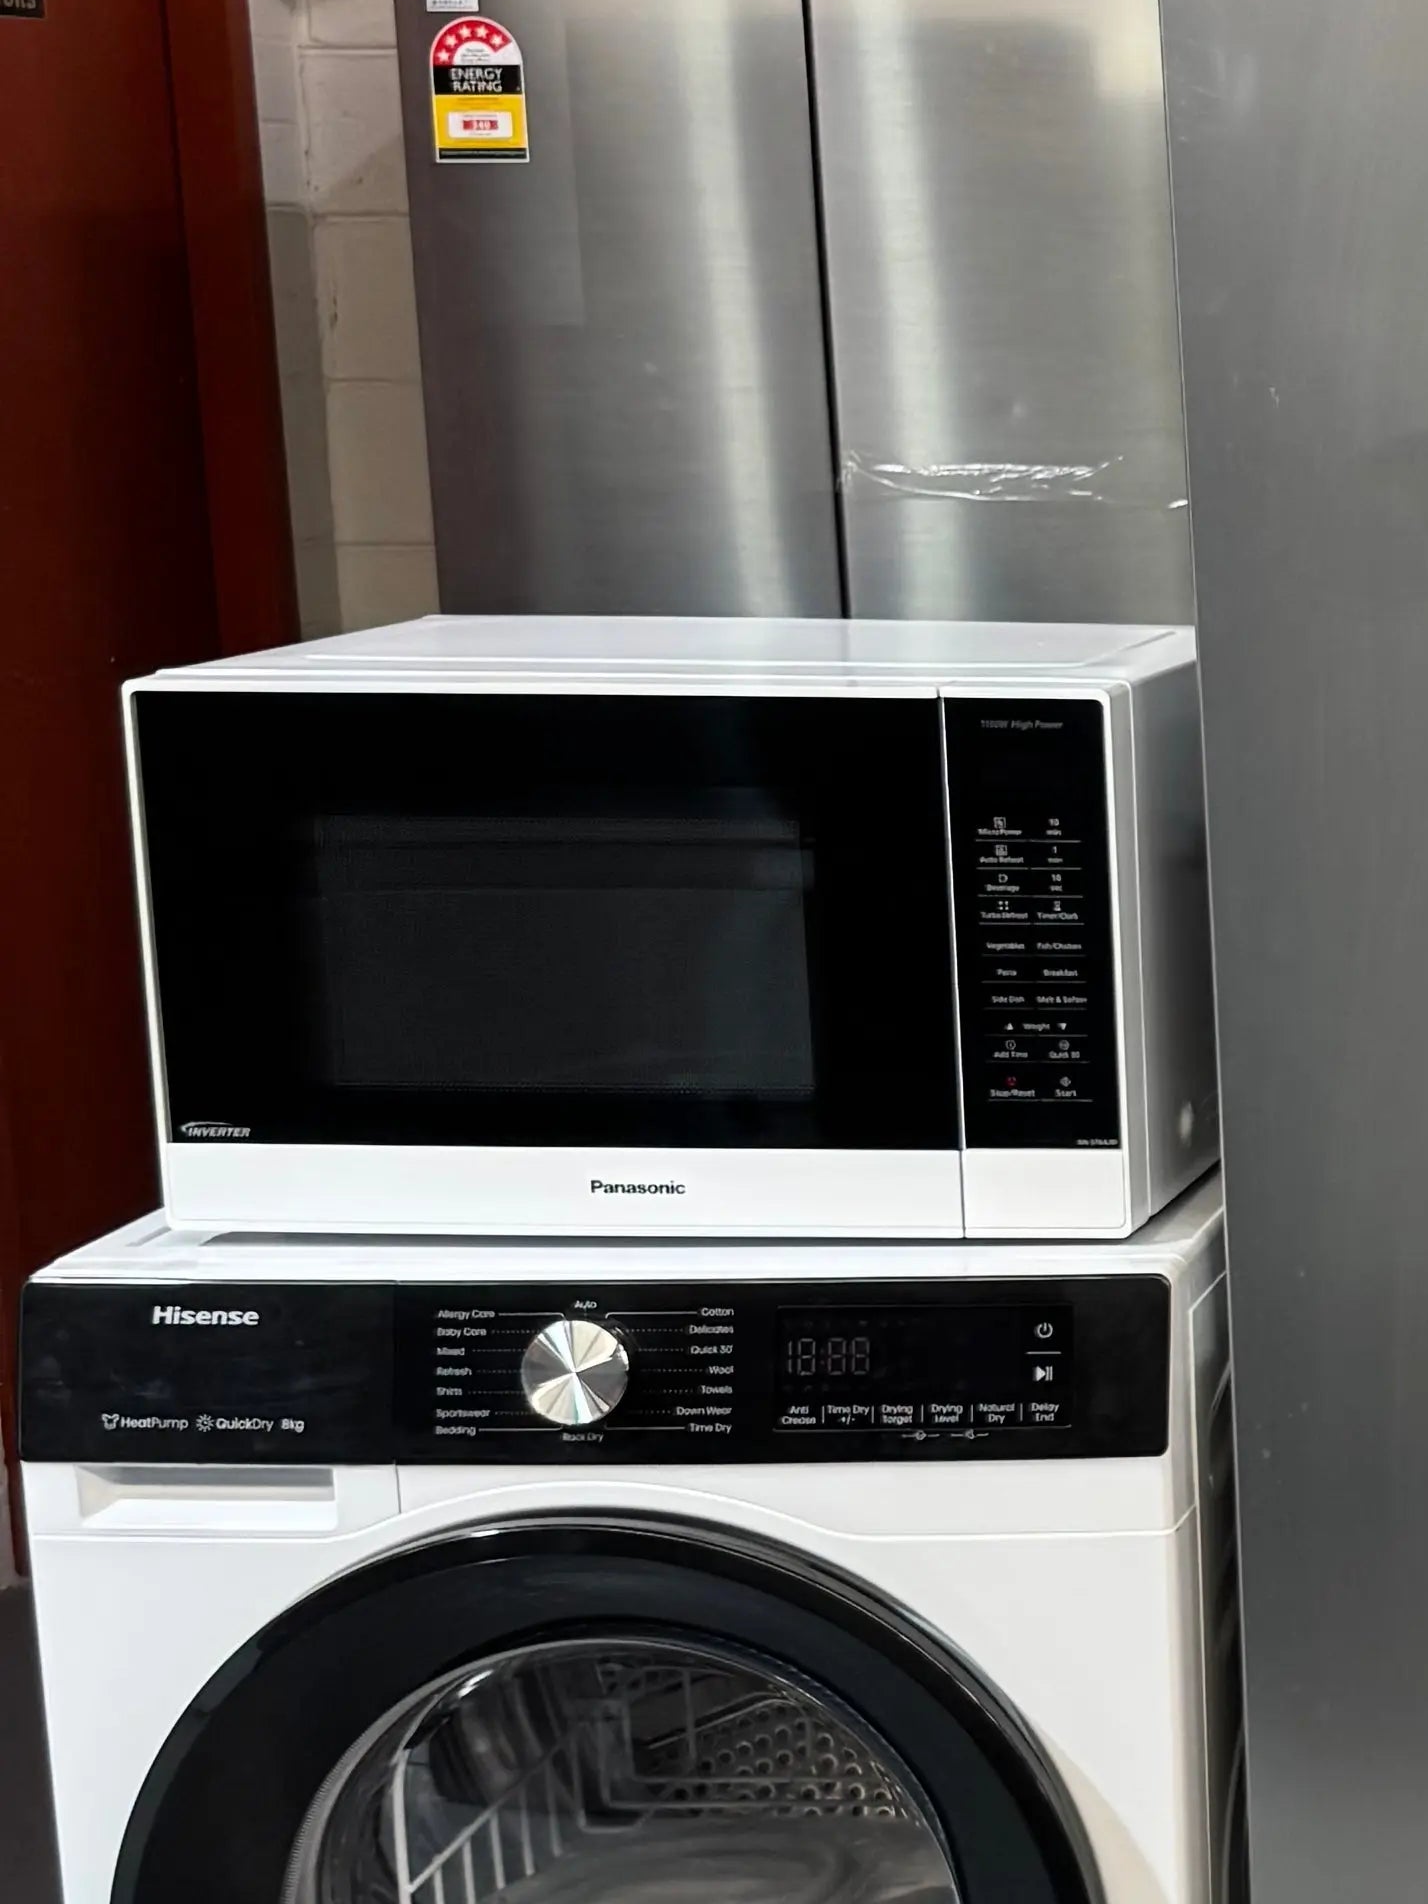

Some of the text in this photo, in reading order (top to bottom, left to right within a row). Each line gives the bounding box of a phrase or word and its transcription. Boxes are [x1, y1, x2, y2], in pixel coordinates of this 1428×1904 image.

[450, 67, 503, 81] ENERGY
[452, 81, 503, 93] RATING
[187, 1125, 251, 1138] INVERTER
[590, 1178, 686, 1195] Panasonic
[152, 1305, 259, 1326] Hisense
[472, 1309, 496, 1318] Care
[701, 1307, 734, 1316] Cotton
[437, 1327, 488, 1338] Baby Care
[689, 1324, 734, 1334] Delicates
[690, 1345, 718, 1354] Quick
[708, 1365, 734, 1375] Wool
[701, 1384, 733, 1394] Towels
[436, 1408, 490, 1419] Sportswear
[676, 1406, 733, 1416] Down Wear
[826, 1405, 870, 1416] Time Dry
[881, 1404, 914, 1416] Drying
[931, 1404, 963, 1416] Drying
[1031, 1402, 1059, 1414] Delay
[988, 1413, 1006, 1425] Dry
[120, 1416, 305, 1434] HeatPump QuickDry 8kg
[690, 1423, 733, 1434] Time Dry
[435, 1425, 476, 1437] Bedding
